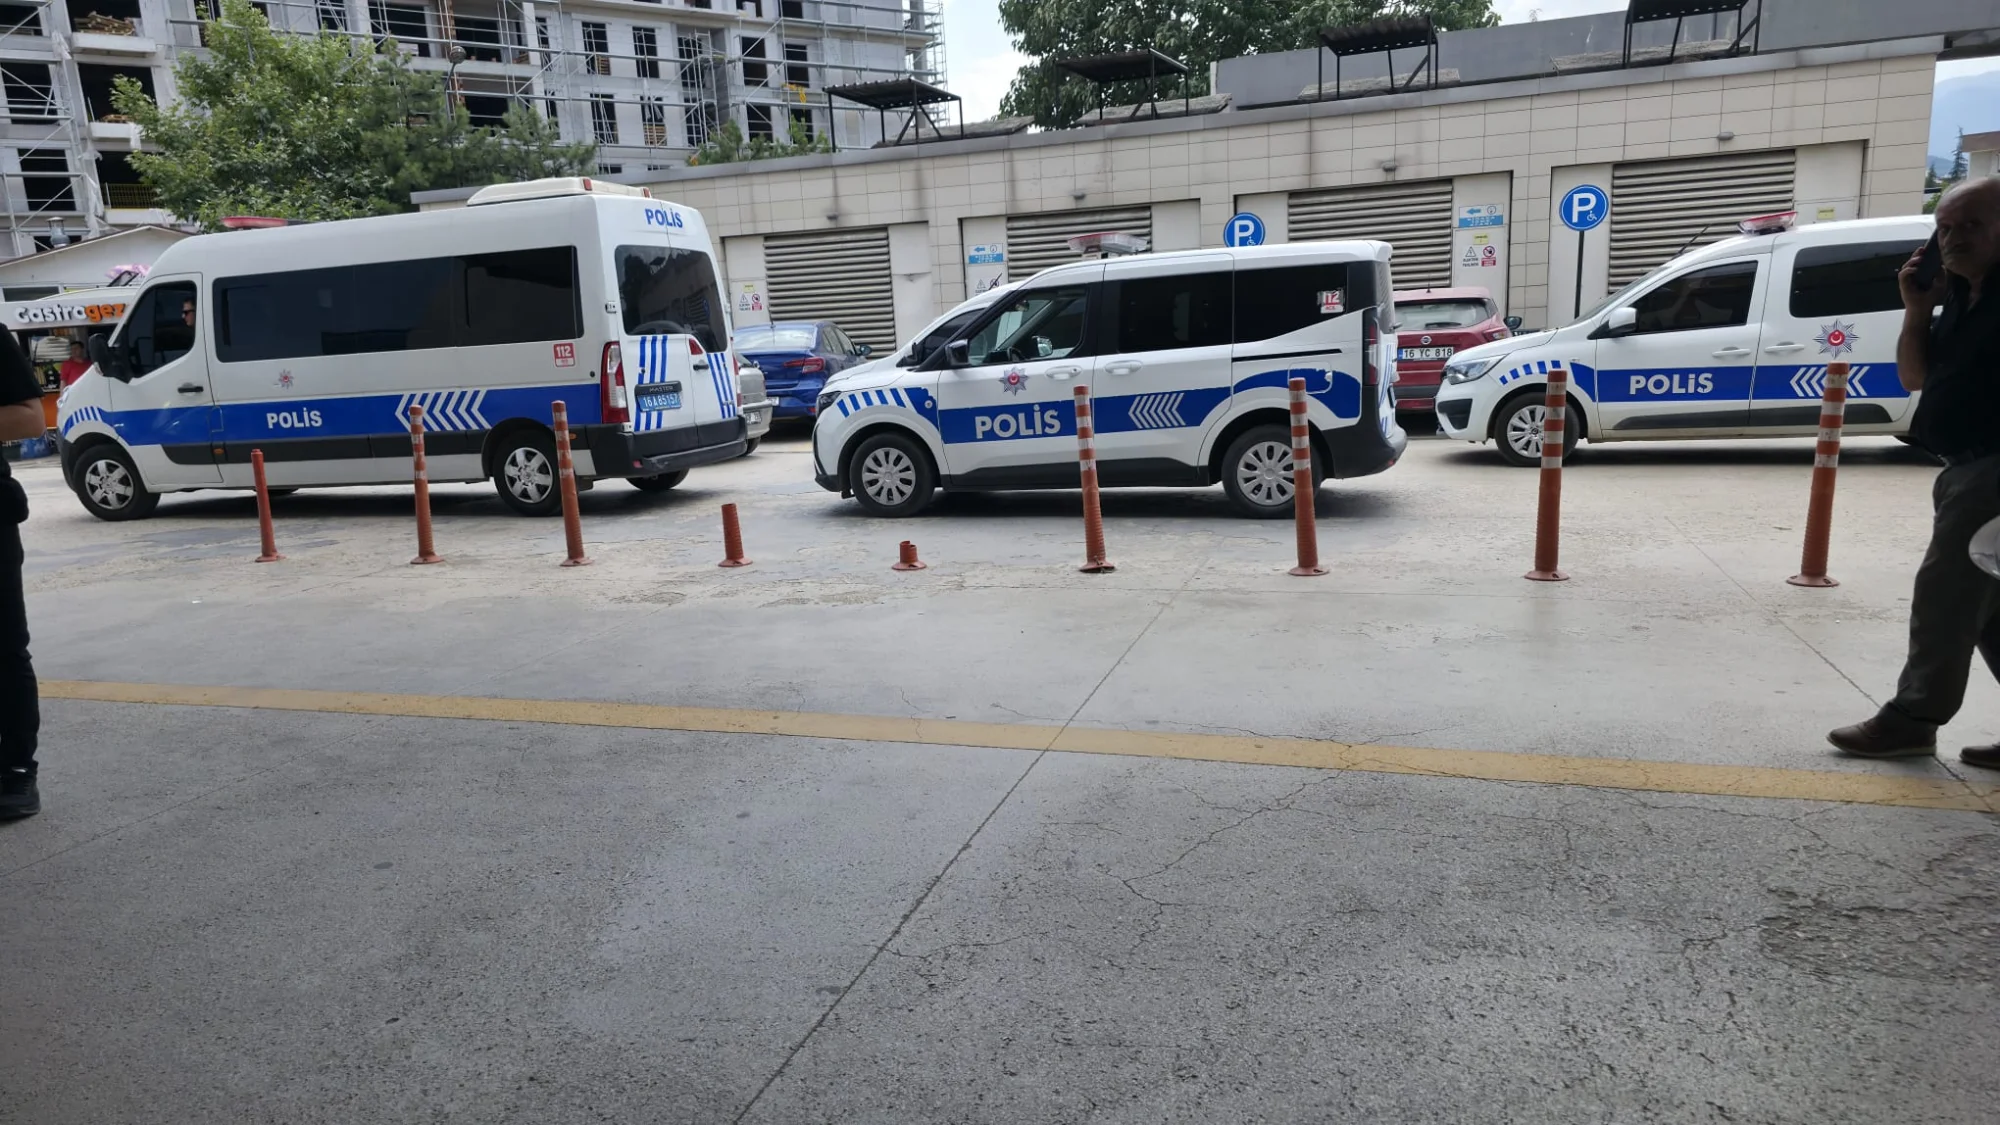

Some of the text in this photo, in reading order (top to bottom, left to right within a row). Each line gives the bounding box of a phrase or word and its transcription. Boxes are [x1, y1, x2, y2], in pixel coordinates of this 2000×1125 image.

[644, 207, 684, 228] POLİS
[1572, 192, 1597, 223] P
[1234, 219, 1255, 247] P
[556, 345, 572, 358] 112
[1404, 347, 1453, 358] 16 YC 818
[266, 406, 323, 429] POLİS
[974, 404, 1061, 439] POLİS
